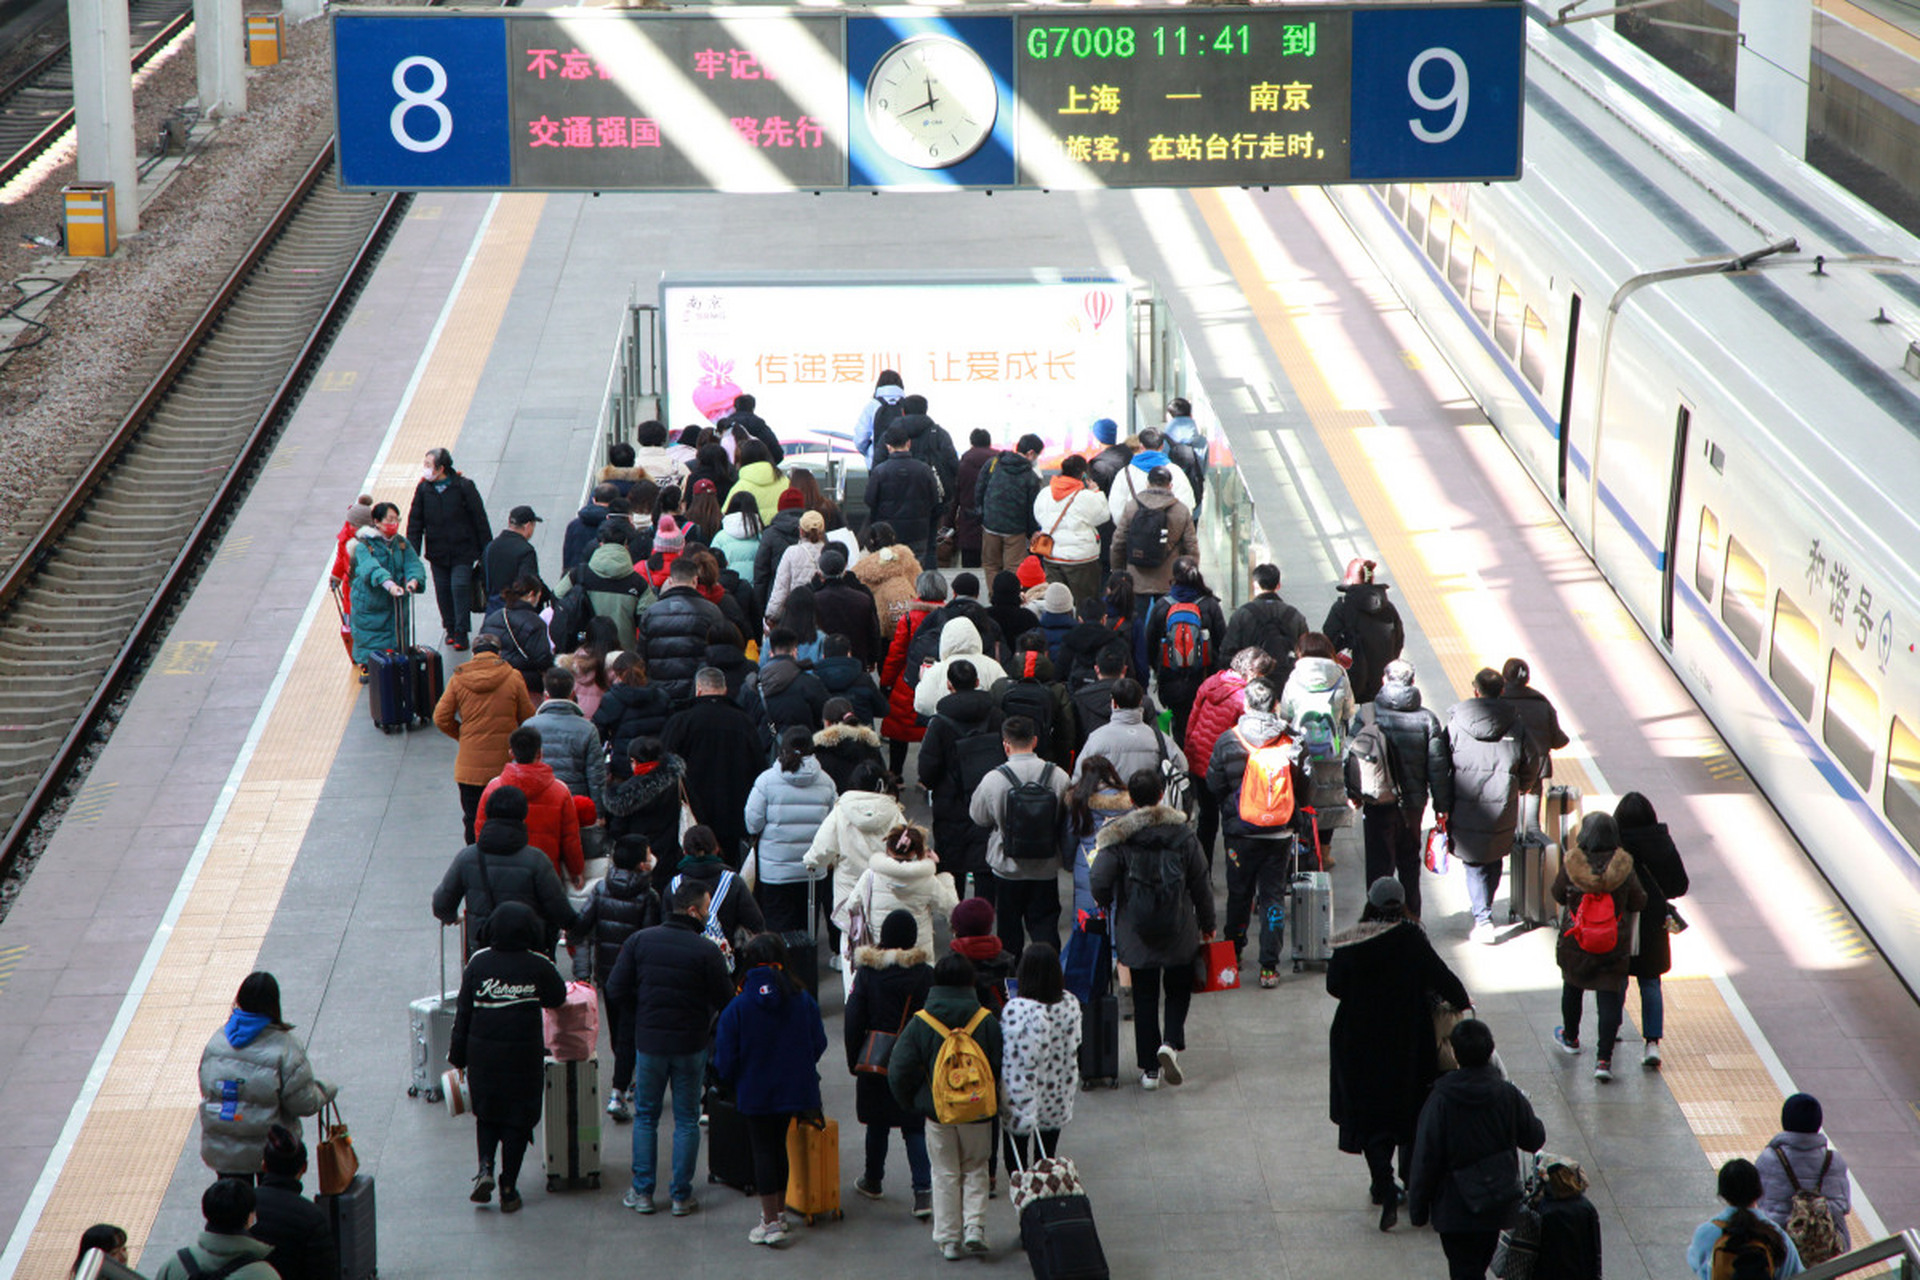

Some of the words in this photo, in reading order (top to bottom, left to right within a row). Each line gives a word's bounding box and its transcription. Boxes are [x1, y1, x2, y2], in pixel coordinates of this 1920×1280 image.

[1027, 27, 1136, 58] G7008
[1153, 25, 1249, 56] 11:41
[1282, 22, 1317, 57] 到
[390, 55, 453, 153] 8
[1058, 84, 1121, 114] 上海
[1250, 80, 1313, 112] 南京
[1408, 47, 1469, 143] 9
[528, 115, 661, 148] 交通强国
[929, 143, 939, 157] 6
[929, 351, 1076, 382] 让爱成长
[1805, 538, 1874, 652] 和谐号
